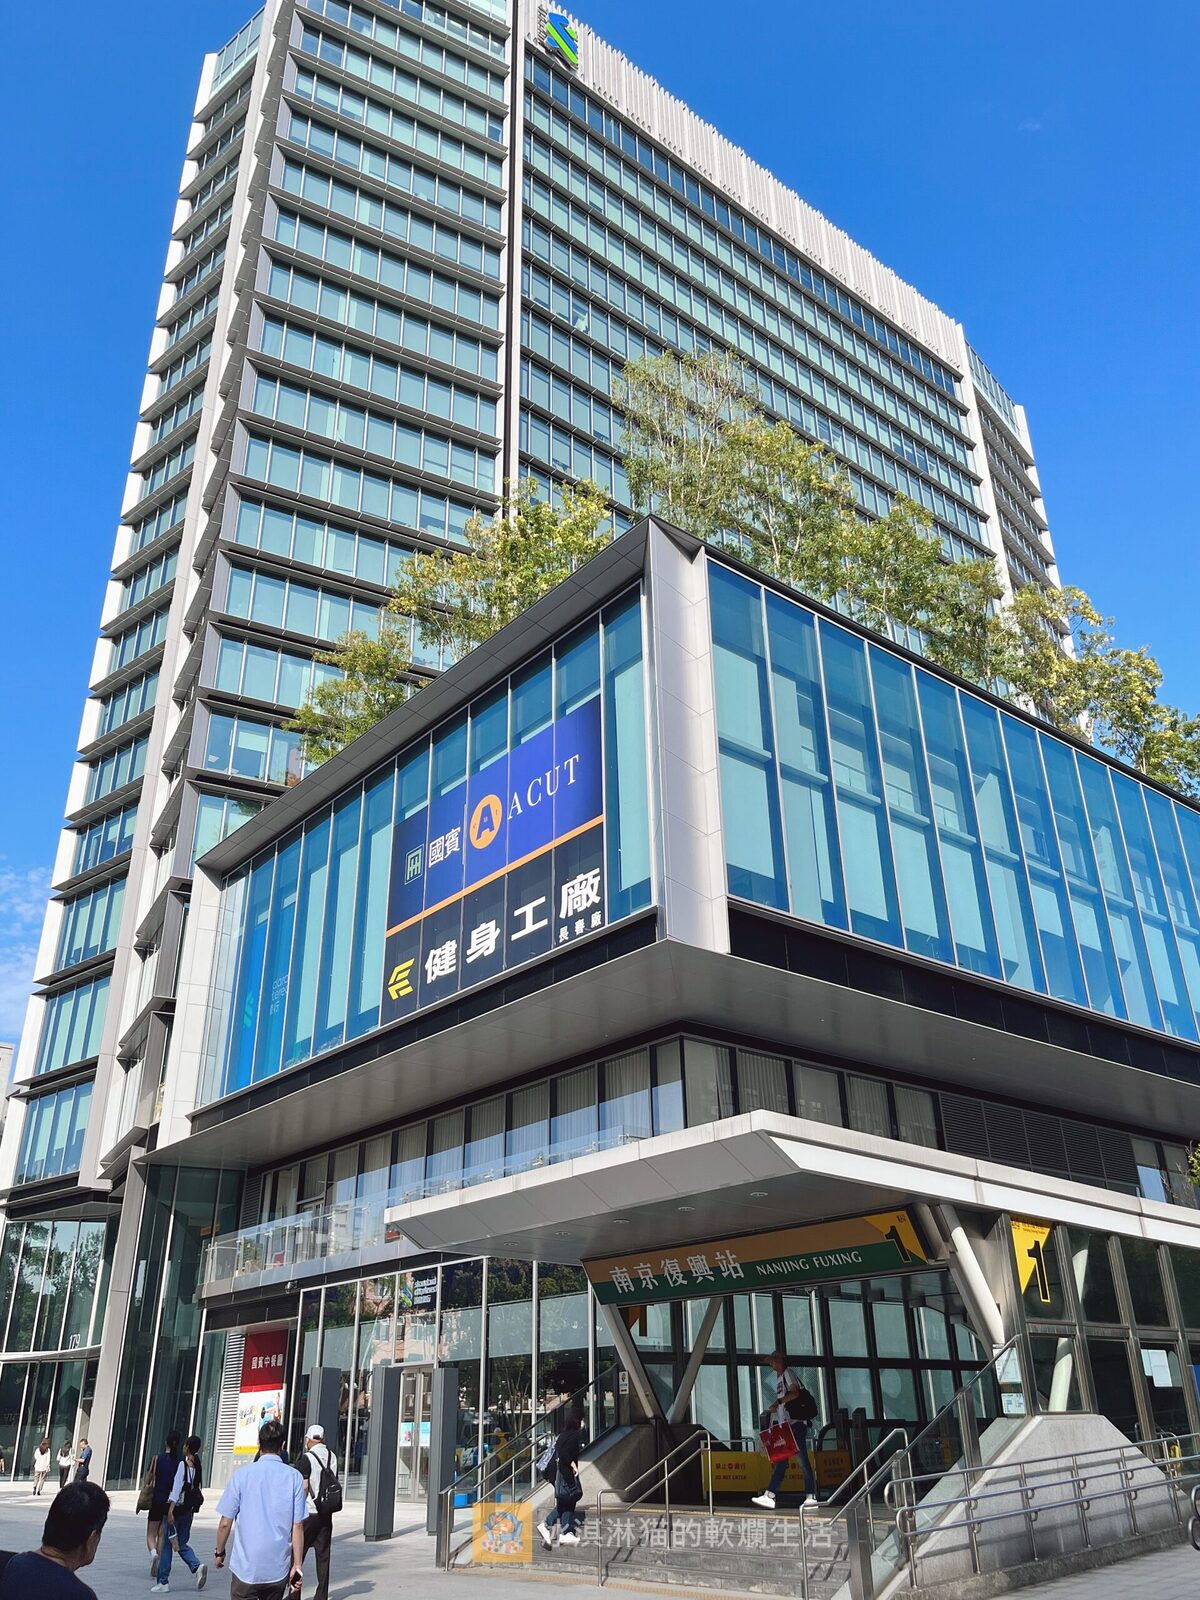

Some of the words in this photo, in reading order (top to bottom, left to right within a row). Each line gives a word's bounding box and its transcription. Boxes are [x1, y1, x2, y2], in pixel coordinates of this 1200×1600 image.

[507, 753, 580, 819] ACUT
[429, 828, 461, 869] 國賓
[425, 867, 602, 984] 健身工廠
[558, 911, 602, 943] 長春廠
[756, 1258, 809, 1276] NANJING
[813, 1251, 862, 1269] FUXING
[885, 1224, 912, 1263] 1
[609, 1250, 745, 1294] 南京復興站
[1027, 1240, 1051, 1303] 1
[70, 1335, 81, 1349] 179
